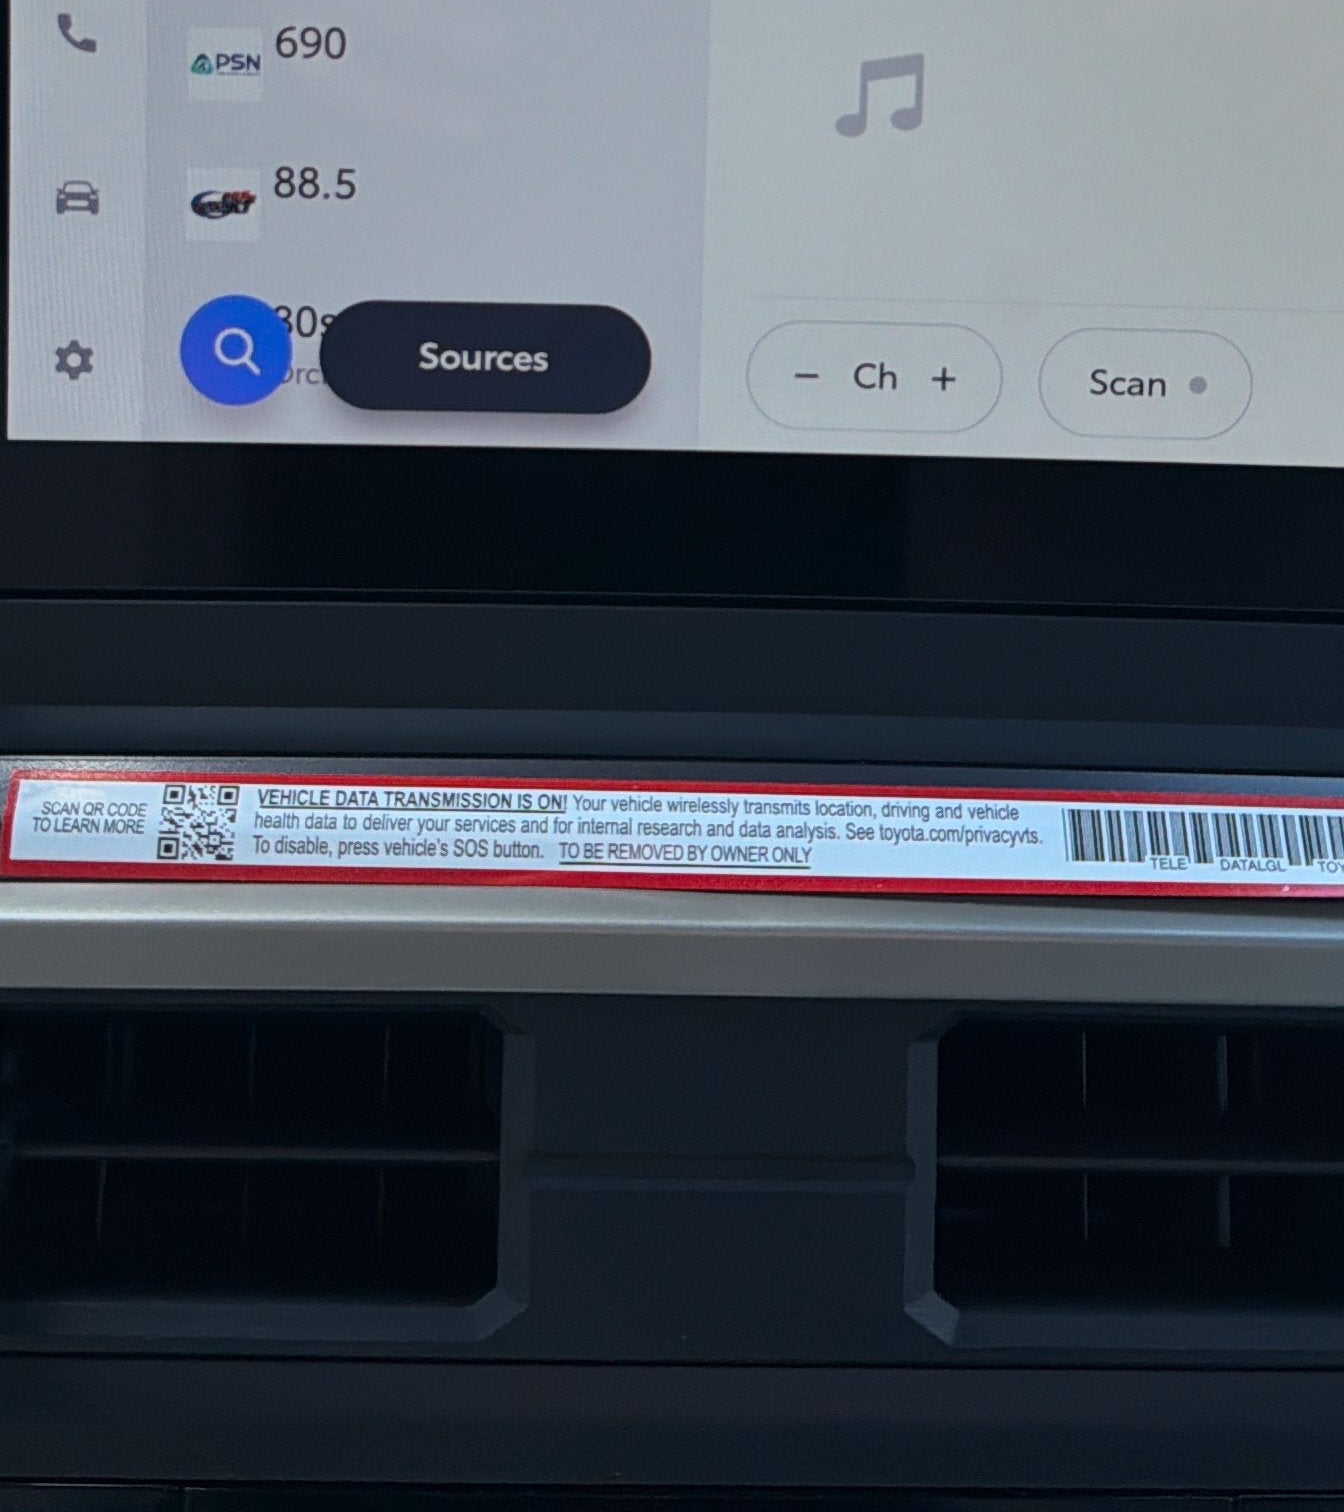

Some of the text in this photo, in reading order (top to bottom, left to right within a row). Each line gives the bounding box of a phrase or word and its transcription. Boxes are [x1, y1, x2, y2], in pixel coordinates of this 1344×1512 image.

[275, 25, 346, 60] 690
[216, 53, 261, 73] PSN
[274, 166, 357, 200] 88.5
[419, 342, 549, 373] Sources
[853, 361, 898, 392] Ch
[1089, 369, 1167, 398] Scan
[41, 801, 148, 817] SCAN QR CODE
[258, 788, 1019, 822] VEHICLE DATA TRANSMISSION IS ON! Your vehicle wirelessly transmits location, driving and vehicle
[33, 817, 145, 834] TO LEARN MORE
[255, 812, 1044, 848] health data to deliver your services and for internal research and data analysis. See toyota.com/privacyvts.
[253, 834, 812, 864] To disable, press vehicle's SOS button. TO BE REMOVED BY OWNER ONLY
[1149, 857, 1188, 871] TELE
